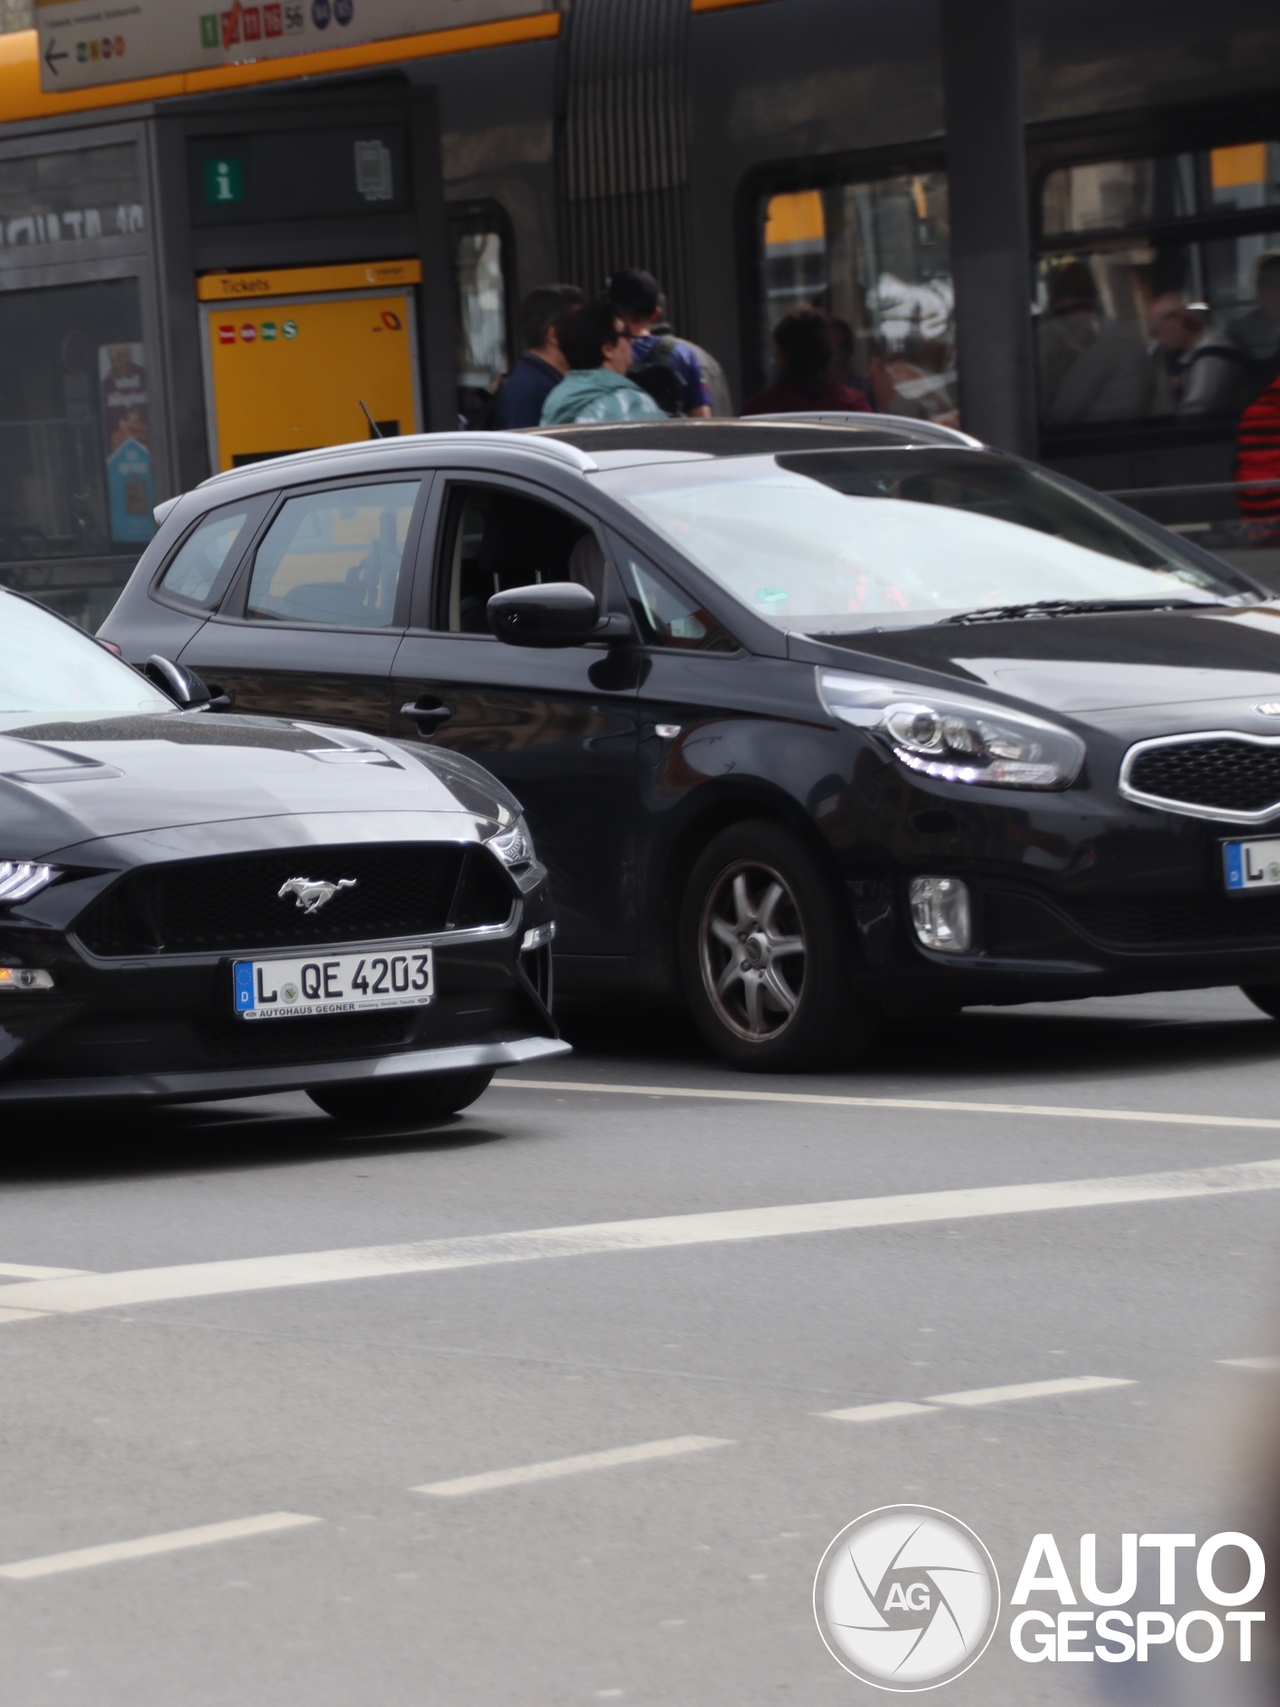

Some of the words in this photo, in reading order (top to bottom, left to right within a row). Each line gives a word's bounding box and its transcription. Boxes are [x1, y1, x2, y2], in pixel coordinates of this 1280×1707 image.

[221, 277, 270, 294] Tickets
[1245, 847, 1263, 881] L
[241, 991, 249, 1002] D
[256, 967, 278, 1003] L
[300, 962, 344, 1000] QE
[351, 954, 429, 996] 4203
[259, 1006, 313, 1018] AUTOHAUS
[315, 1002, 355, 1013] GEGNER
